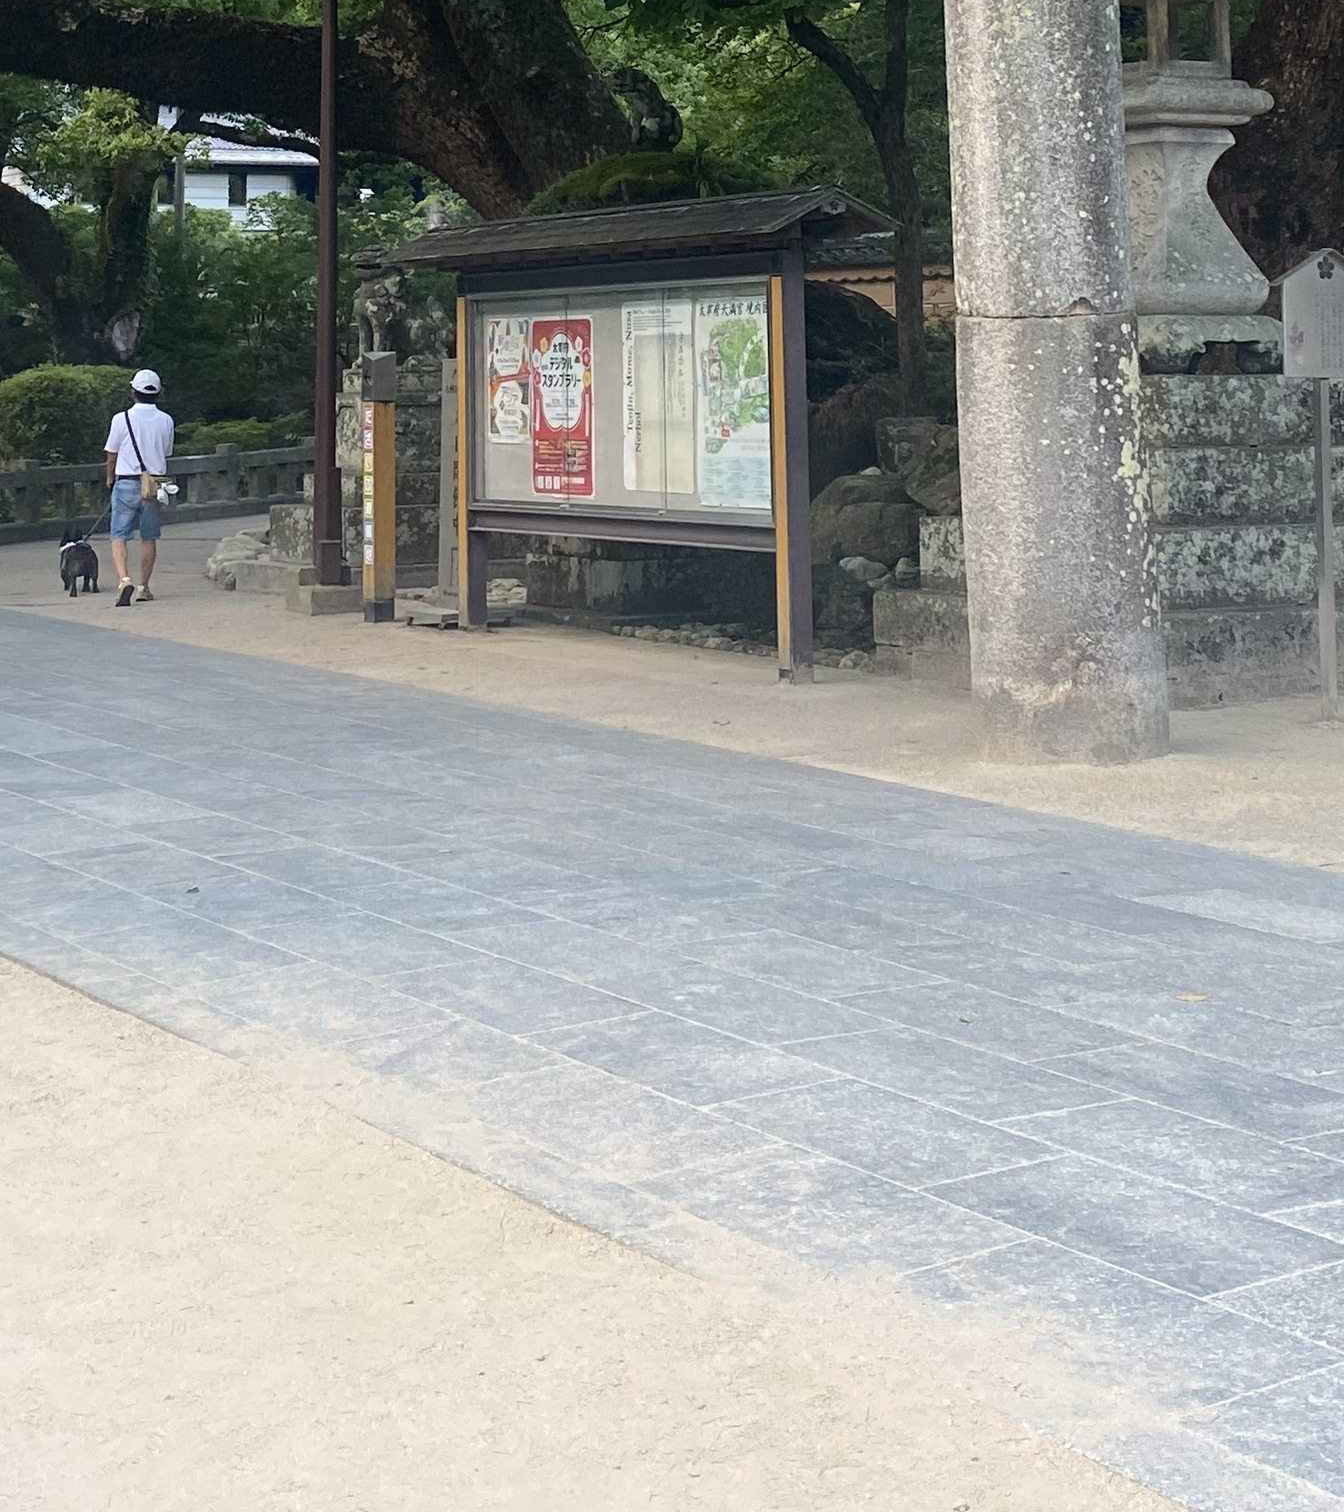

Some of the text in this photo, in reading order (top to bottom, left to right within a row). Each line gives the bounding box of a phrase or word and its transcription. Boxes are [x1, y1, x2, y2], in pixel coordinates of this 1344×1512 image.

[549, 356, 574, 372] デジタル
[541, 373, 582, 388] スタンプラリー
